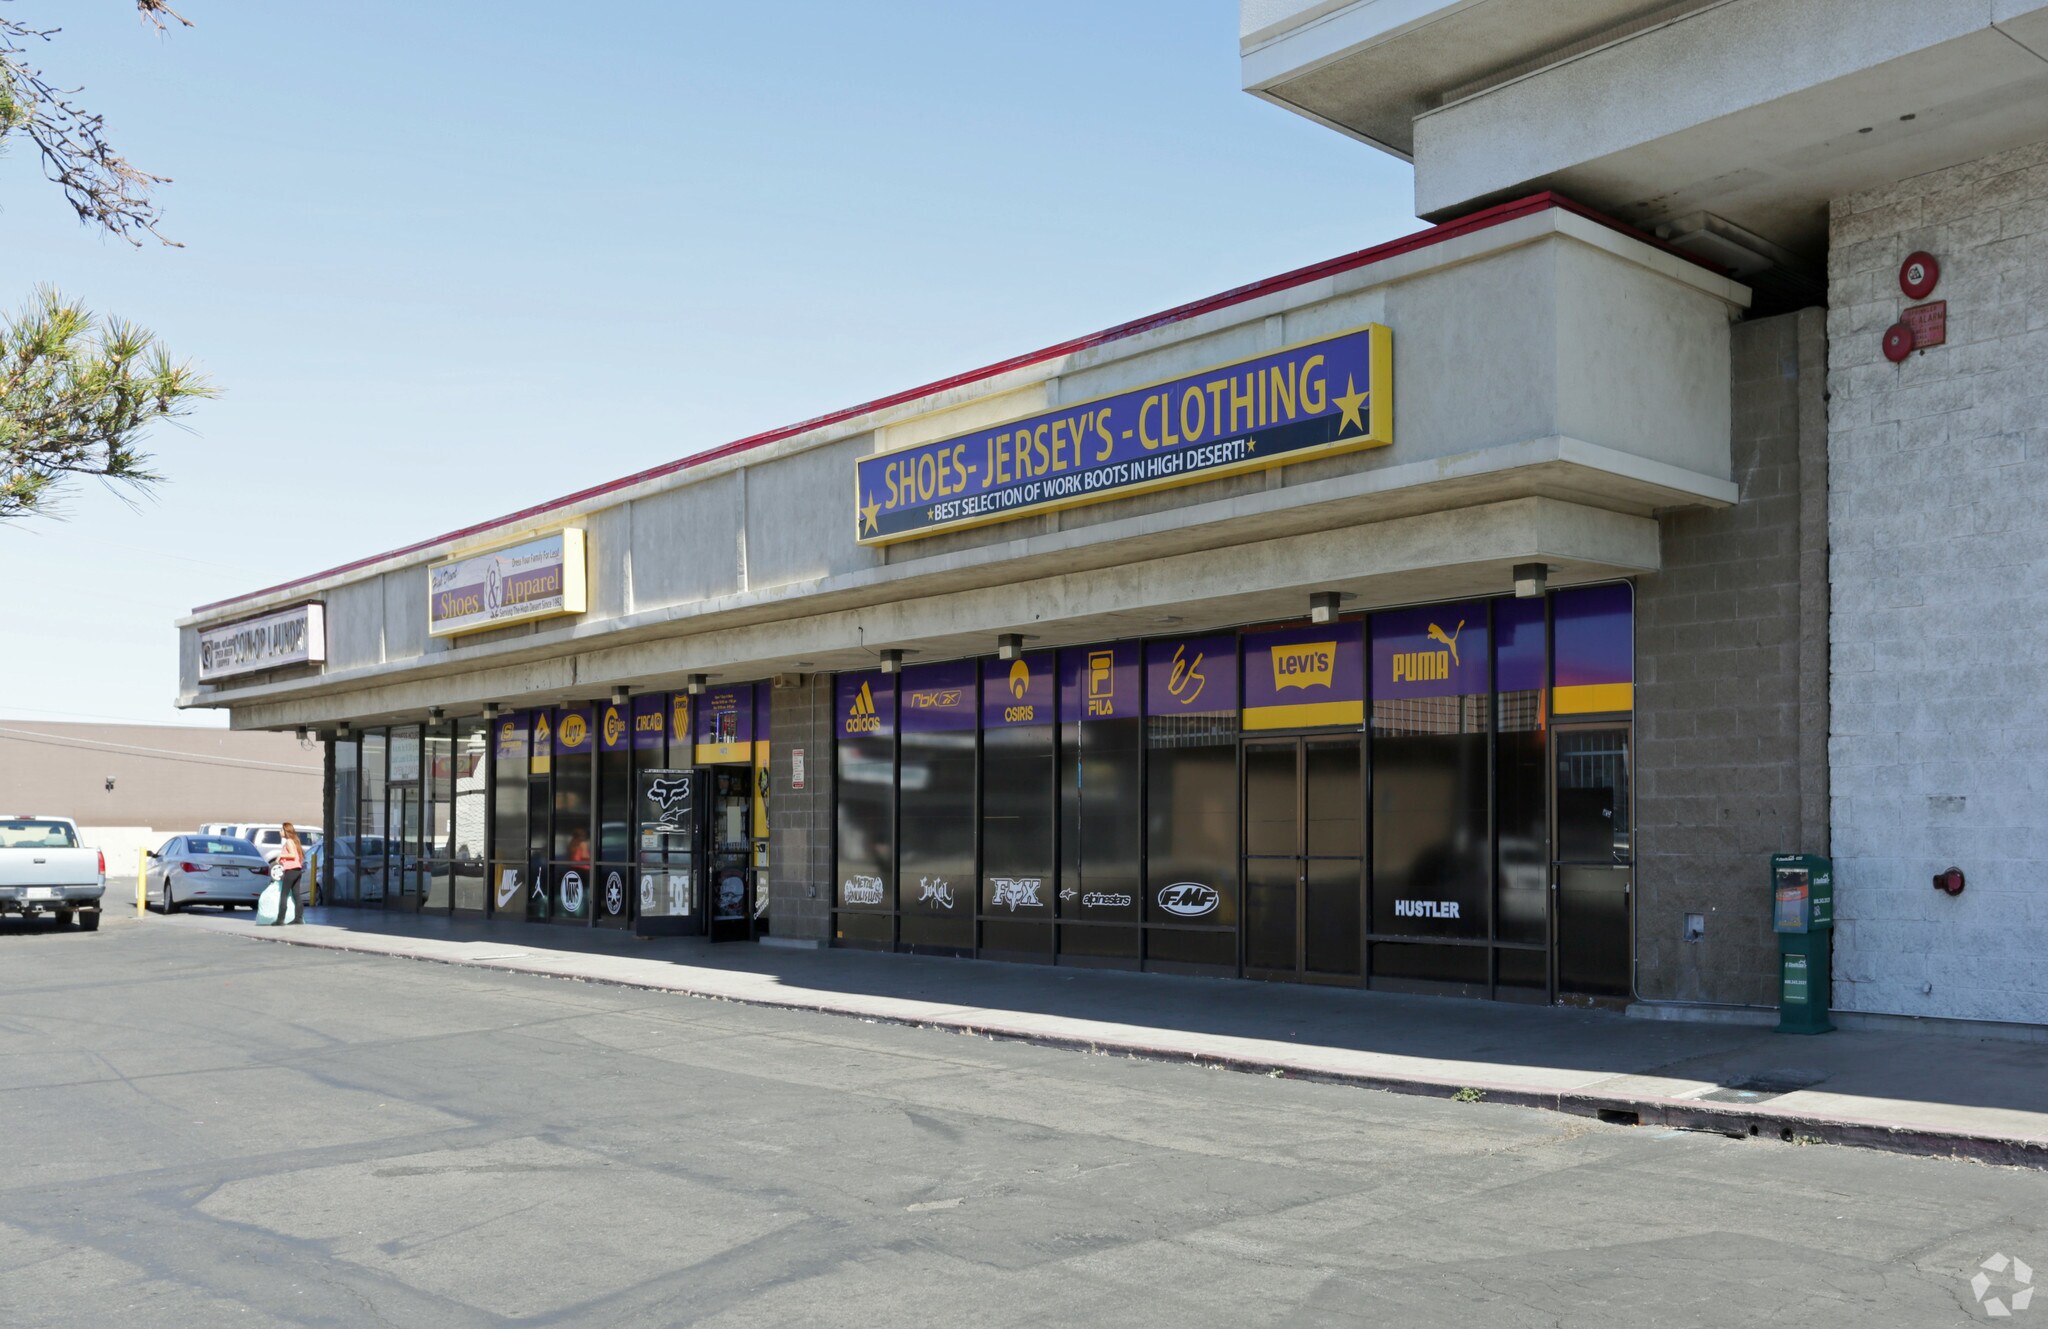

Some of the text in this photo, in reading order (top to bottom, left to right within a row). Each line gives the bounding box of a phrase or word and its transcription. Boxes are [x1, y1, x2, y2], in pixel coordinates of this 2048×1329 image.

[885, 443, 977, 510] SHOES-
[982, 407, 1113, 488] JERSEY'S
[1138, 354, 1326, 450] CLOTHING
[934, 438, 1245, 521] BEST SELECTION OF WORK BOOTS IN HIGH DESERT!
[441, 567, 560, 619] Shoes & Apparel
[1393, 651, 1448, 682] PUMA
[1005, 705, 1034, 722] OSIRIS
[1088, 699, 1113, 716] FILA
[846, 712, 881, 733] adidas
[502, 869, 518, 890] NIKE
[1082, 892, 1131, 907] alpinestars
[1159, 887, 1218, 907] FMF
[1395, 899, 1460, 919] HUSTLER
